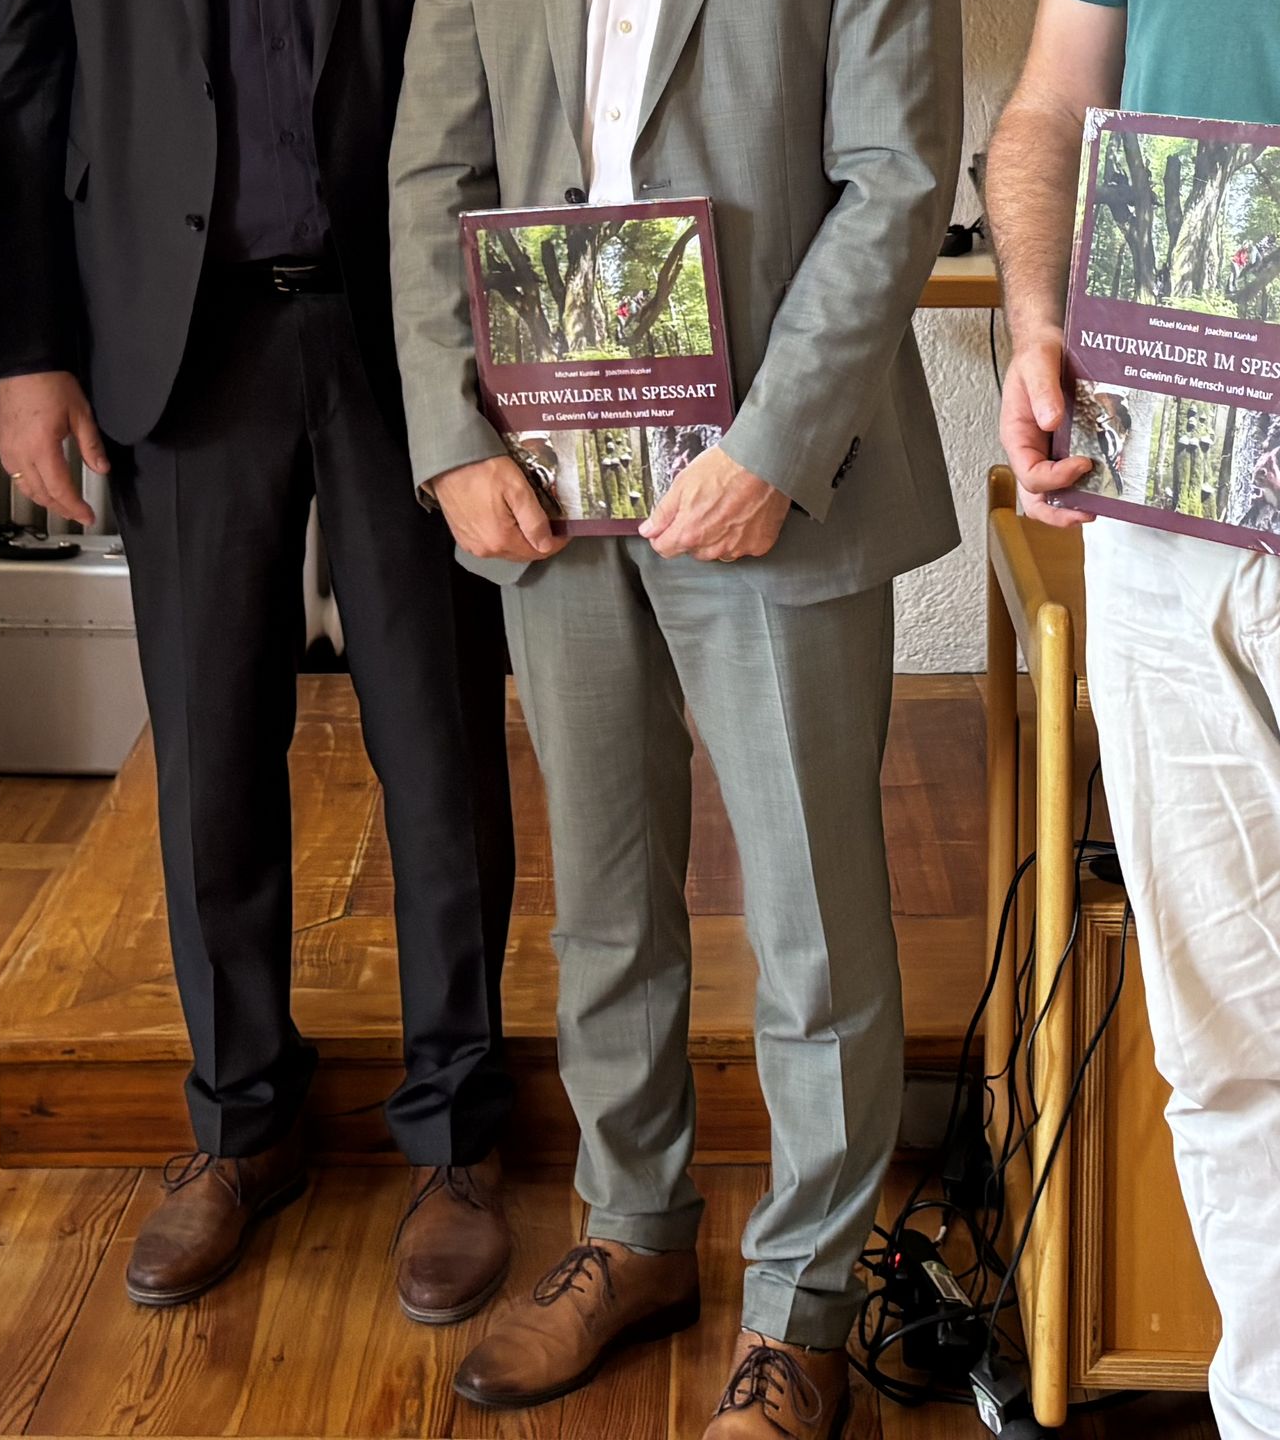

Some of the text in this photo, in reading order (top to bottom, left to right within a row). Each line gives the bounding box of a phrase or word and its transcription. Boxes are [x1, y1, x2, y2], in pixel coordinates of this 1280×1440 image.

[1081, 330, 1207, 367] NATURWÄLDER
[1214, 353, 1235, 371] IM
[497, 384, 717, 406] NATURWÄLDER IM SPESSART
[1124, 366, 1273, 400] Ein Gewinn für Mensch und Natur
[542, 409, 675, 421] Ein Gewinn für Mensch und Natur
